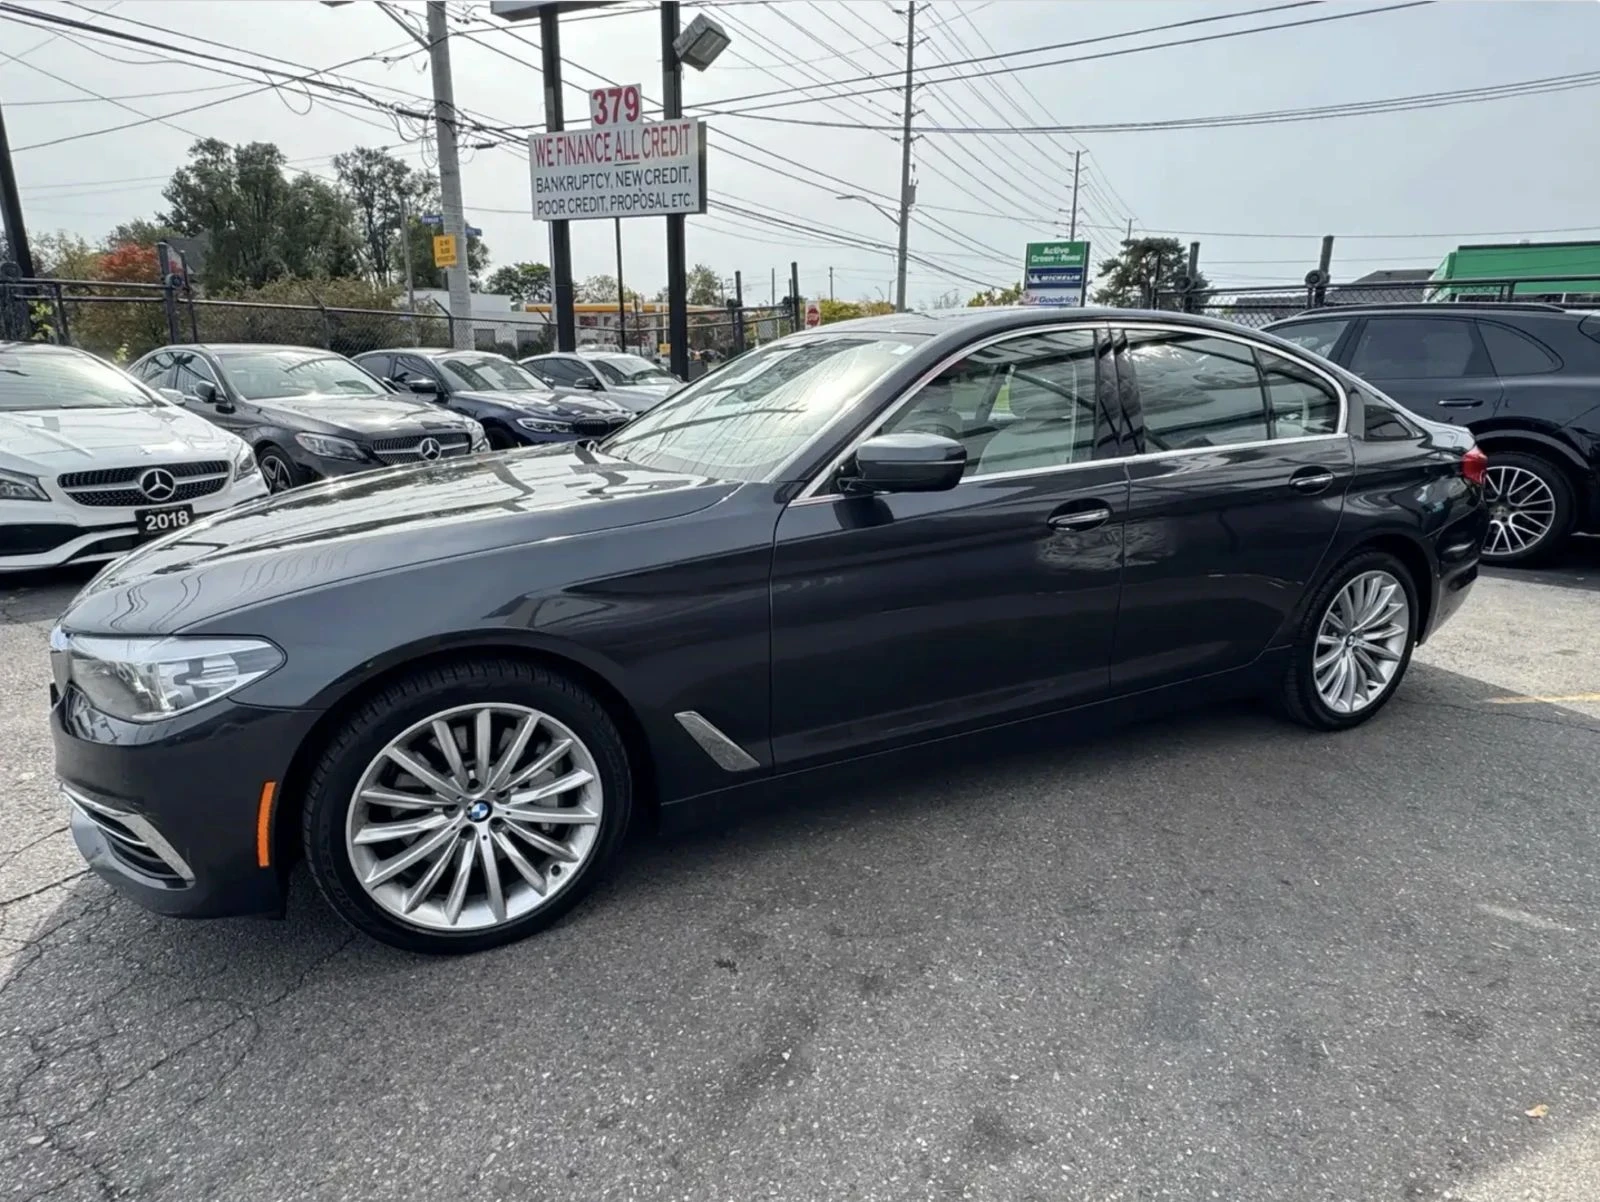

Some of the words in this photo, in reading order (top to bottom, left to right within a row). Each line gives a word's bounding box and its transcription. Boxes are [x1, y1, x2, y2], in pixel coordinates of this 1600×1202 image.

[592, 87, 640, 125] 379
[534, 138, 555, 168] WE
[556, 132, 612, 167] FINANCE
[615, 129, 640, 161] ALL
[641, 124, 691, 159] CREDIT
[616, 169, 643, 187] NEW
[537, 198, 566, 216] POOR
[610, 192, 669, 211] PROPOSAL
[671, 192, 694, 207] ETC.
[144, 510, 190, 530] 2018
